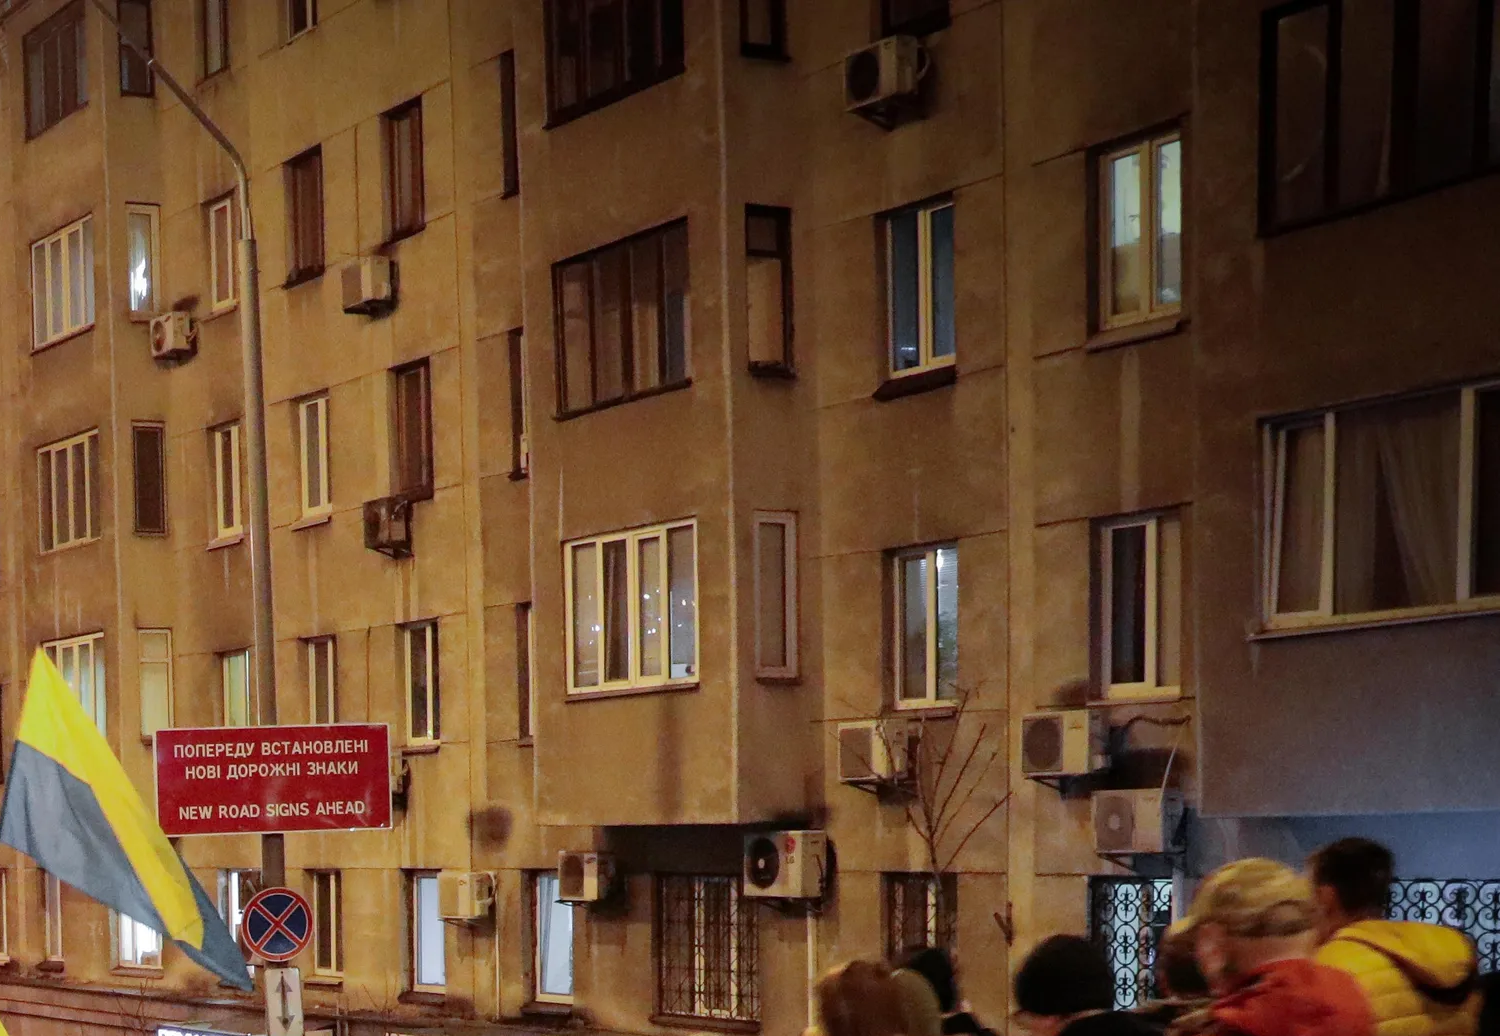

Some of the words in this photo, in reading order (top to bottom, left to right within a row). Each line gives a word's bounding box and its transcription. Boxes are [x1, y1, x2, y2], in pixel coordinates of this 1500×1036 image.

[173, 742, 255, 759] ПОПЕРЕДУ
[261, 739, 369, 756] ВСТАНОВЛЕНІ
[185, 765, 221, 780] НОВІ
[226, 762, 301, 780] ДОРОЖНІ
[307, 761, 359, 776] ЗНАКИ
[179, 805, 213, 820] NEW
[218, 804, 260, 819] ROAD
[265, 802, 310, 817] SIGNS
[315, 801, 366, 816] AHEAD
